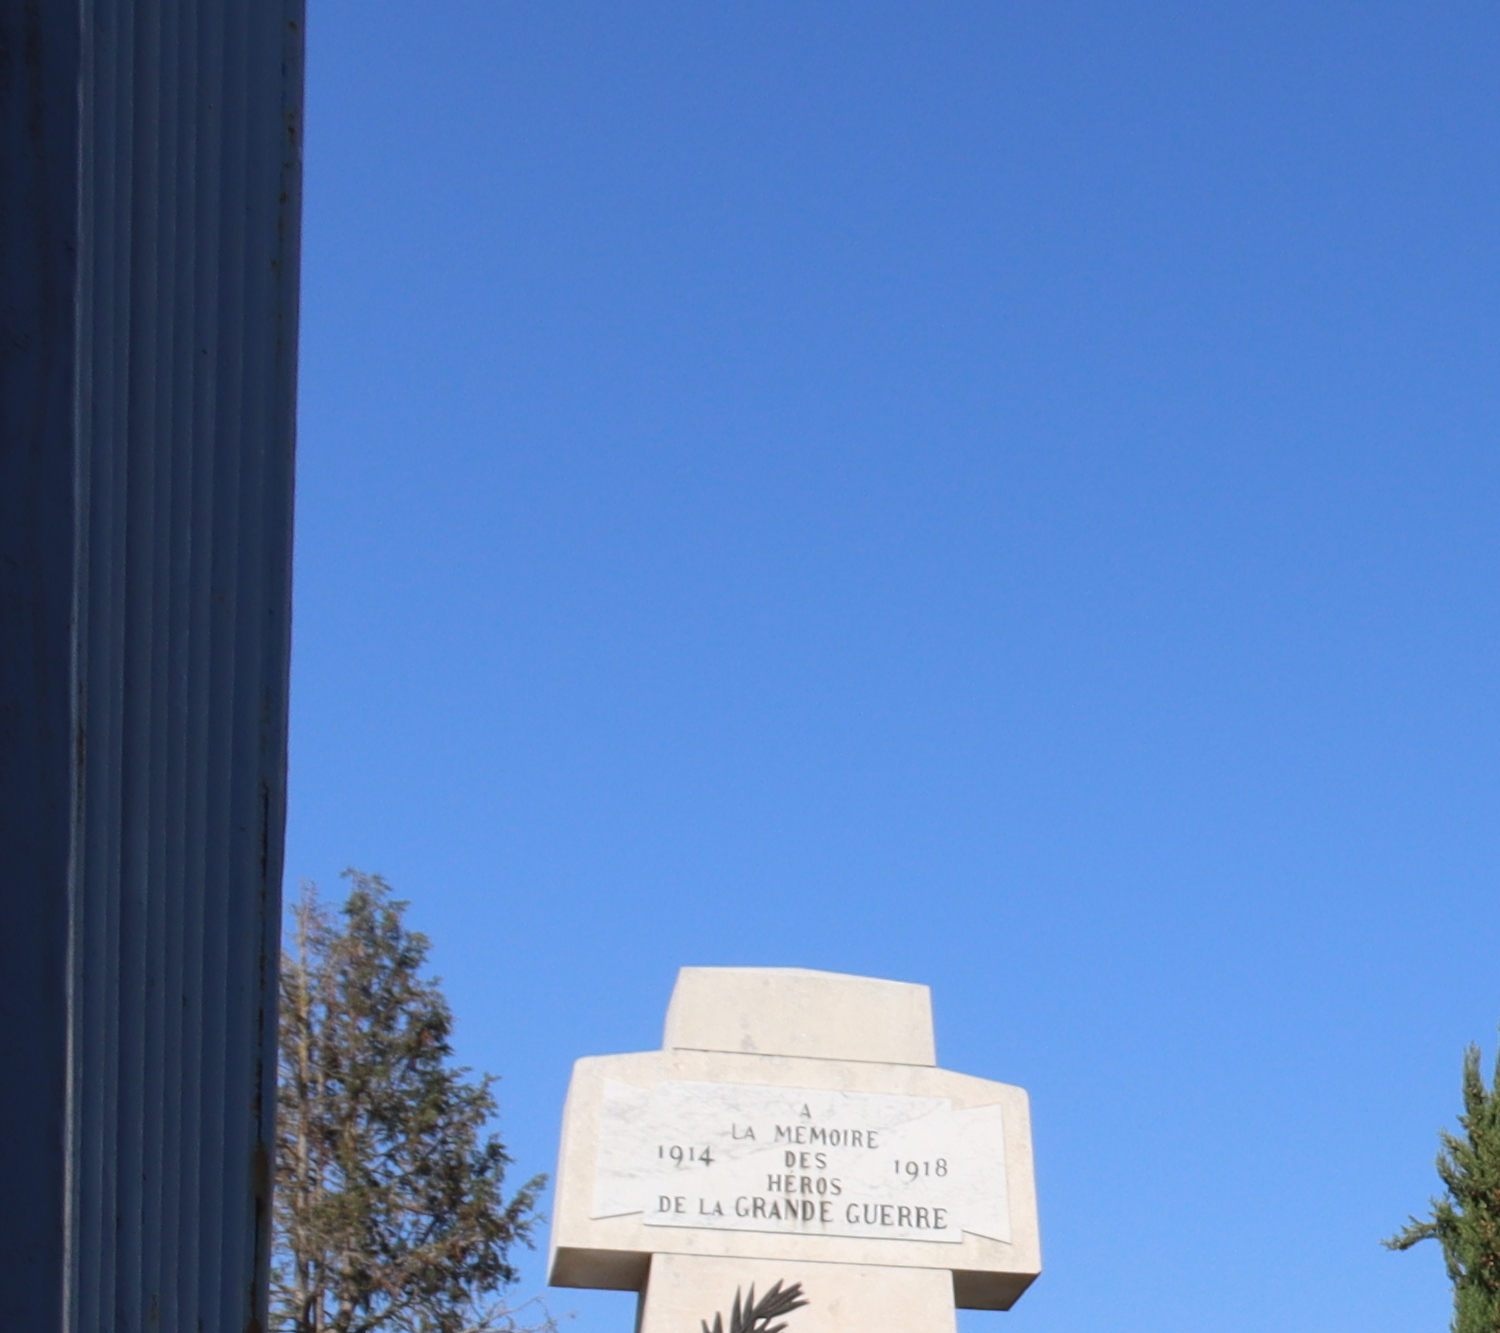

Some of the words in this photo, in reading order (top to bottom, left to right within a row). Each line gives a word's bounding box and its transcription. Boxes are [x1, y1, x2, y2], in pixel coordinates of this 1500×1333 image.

[732, 1123, 756, 1141] LA
[659, 1145, 714, 1167] 1914
[785, 1151, 827, 1169] DES
[894, 1158, 948, 1181] 1918
[767, 1169, 842, 1195] HÉROS
[658, 1195, 686, 1213] DE
[699, 1198, 724, 1216] LA
[735, 1197, 833, 1223] GRANDE
[845, 1203, 948, 1230] GUERRE
